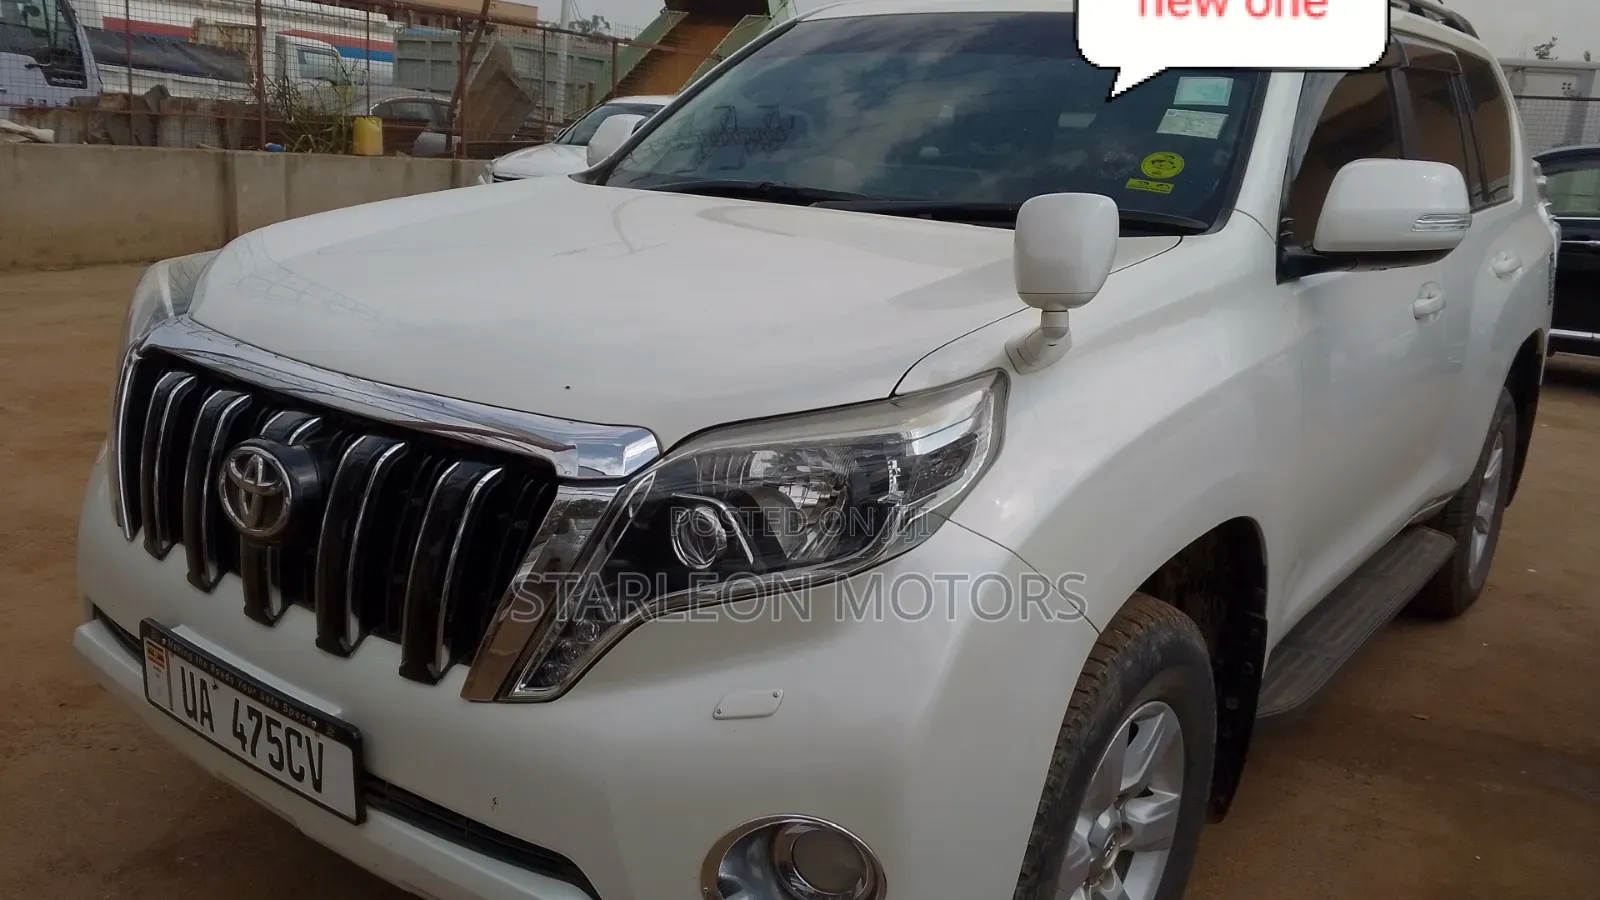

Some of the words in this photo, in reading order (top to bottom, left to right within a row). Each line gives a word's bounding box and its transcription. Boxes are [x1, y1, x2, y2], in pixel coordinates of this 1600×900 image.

[180, 665, 215, 733] UA
[232, 697, 324, 793] 475CV
[237, 680, 257, 695] Your
[260, 691, 280, 708] Safe
[283, 703, 313, 724] Space
